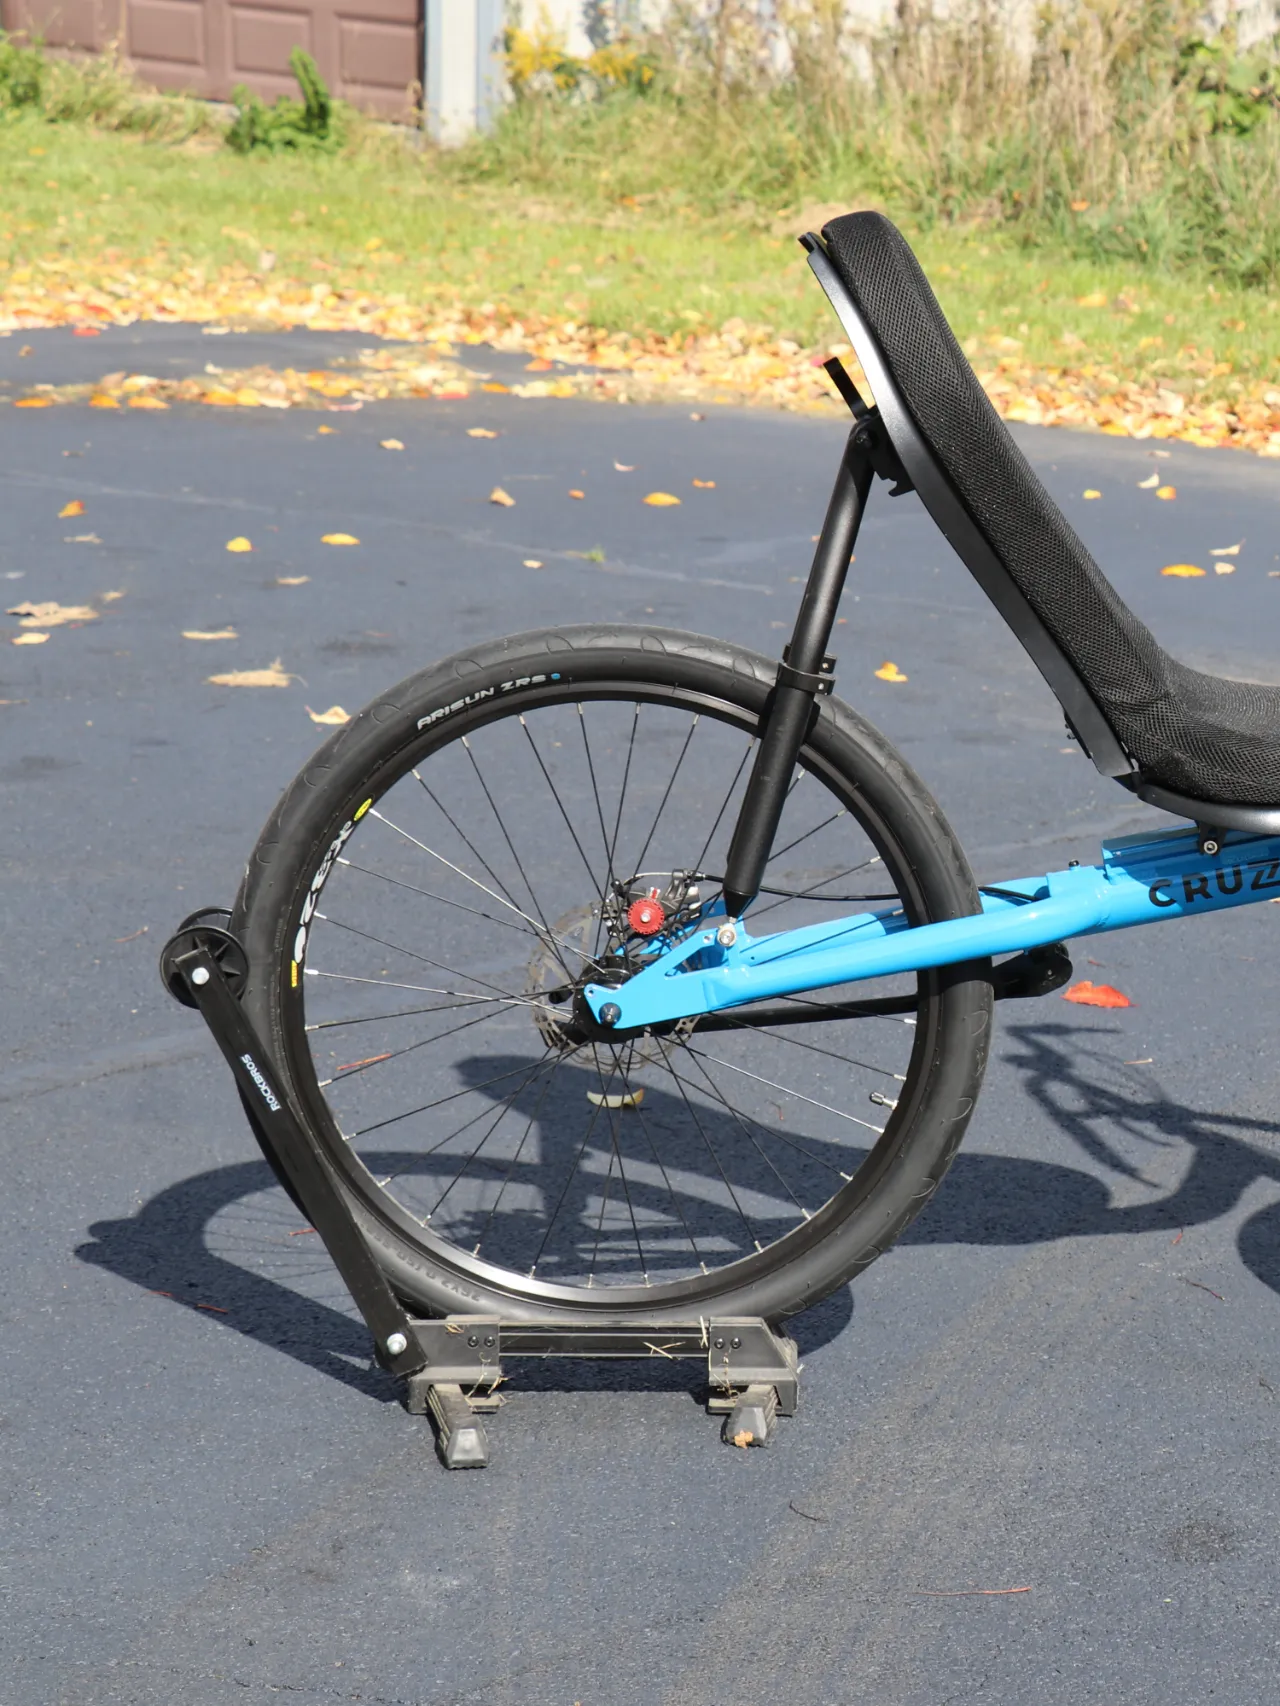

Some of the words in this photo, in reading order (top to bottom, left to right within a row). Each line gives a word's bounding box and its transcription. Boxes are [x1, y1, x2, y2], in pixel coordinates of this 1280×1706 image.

[417, 686, 495, 730] ARISUN
[500, 674, 547, 692] ZRS
[240, 1053, 282, 1112] ROCKBROS
